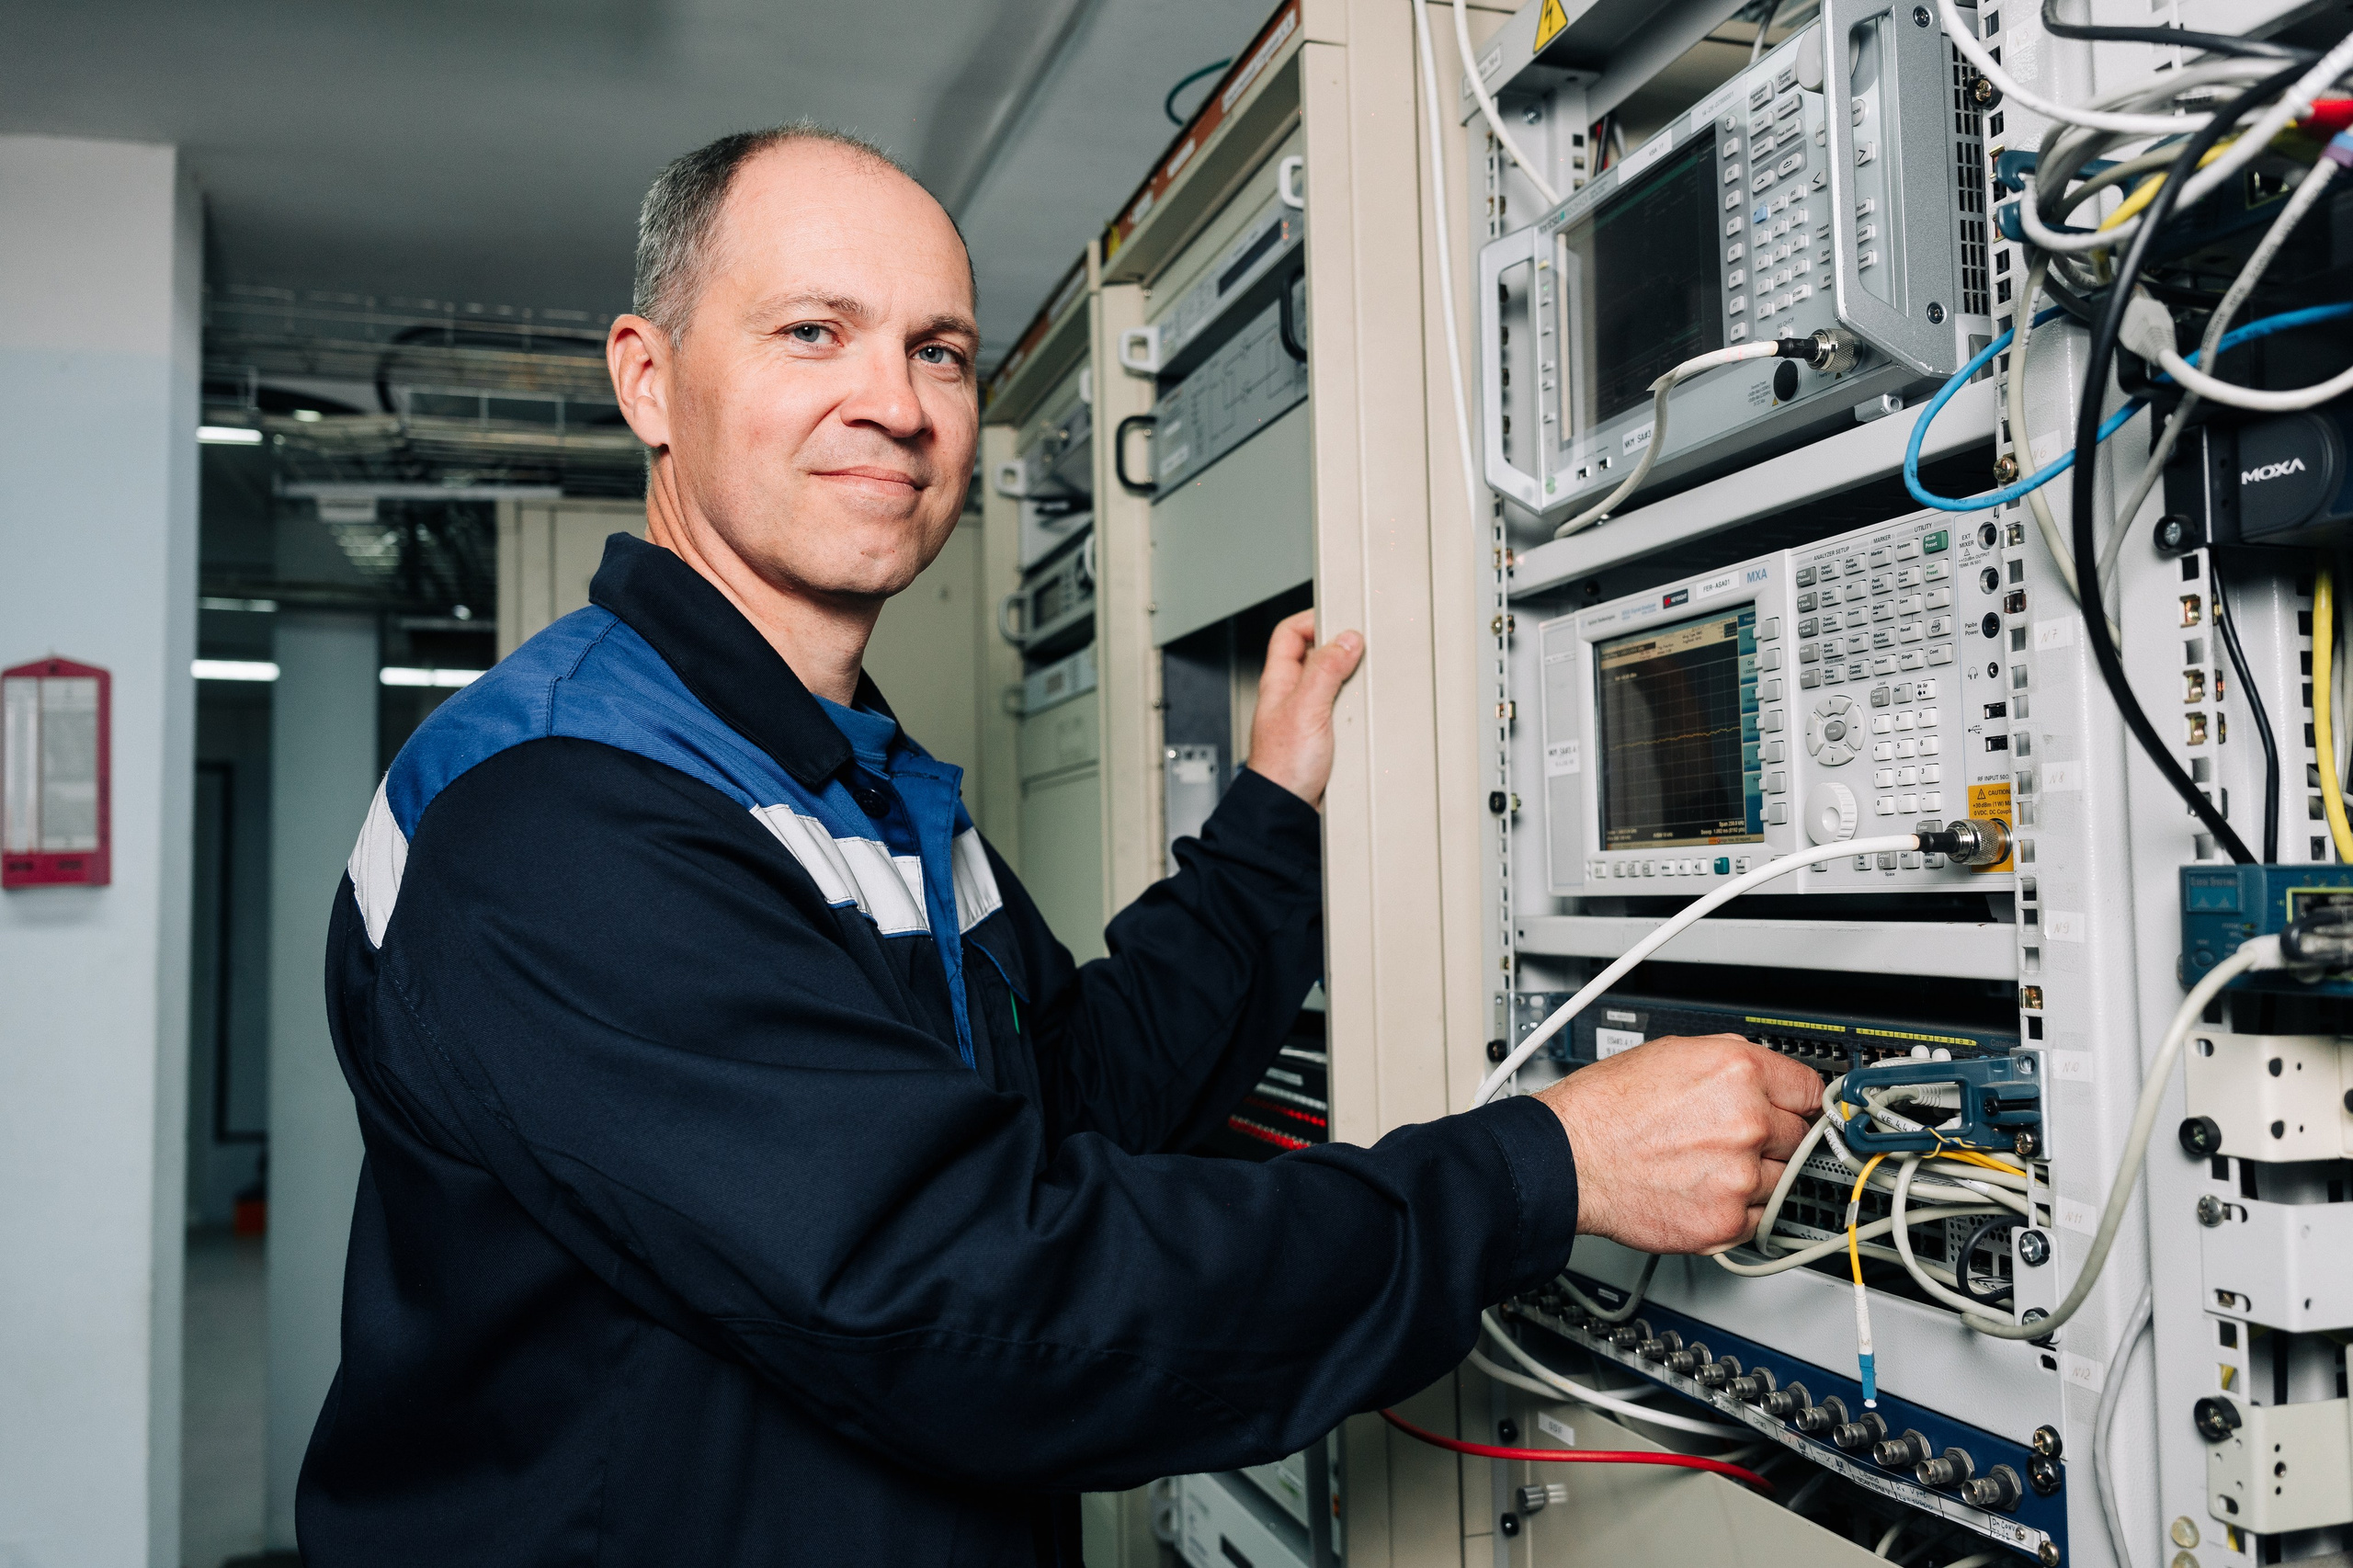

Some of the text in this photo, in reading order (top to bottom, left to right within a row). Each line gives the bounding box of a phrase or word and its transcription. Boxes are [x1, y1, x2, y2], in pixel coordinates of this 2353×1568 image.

[1778, 69, 1791, 81] System
[1778, 75, 1790, 86] Config
[1778, 100, 1794, 113] Measure
[1755, 119, 1765, 129] Trace
[1785, 124, 1797, 134] Search
[1754, 143, 1767, 154] Marker
[1816, 223, 1829, 233] Freque
[1792, 289, 1804, 298] Enter
[2241, 458, 2306, 485] MOXA
[1914, 523, 1933, 533] UTILITY
[1873, 535, 1892, 544] MARKER
[1925, 540, 1938, 549] Preset
[1960, 540, 1975, 549] MIXER
[1813, 546, 1850, 562] ANALYZER SETUP
[1976, 551, 1991, 560] OUTPUT
[1746, 568, 1768, 585] MXA
[1703, 579, 1731, 593] FER-ASA01
[1822, 594, 1835, 602] Display
[1823, 619, 1837, 628] Detector
[2040, 629, 2058, 643] N7
[2050, 771, 2065, 785] N8
[2053, 923, 2070, 935] N9
[2063, 1062, 2079, 1074] N10
[2072, 1367, 2091, 1381] N12
[1993, 1518, 2001, 1527] Dn
